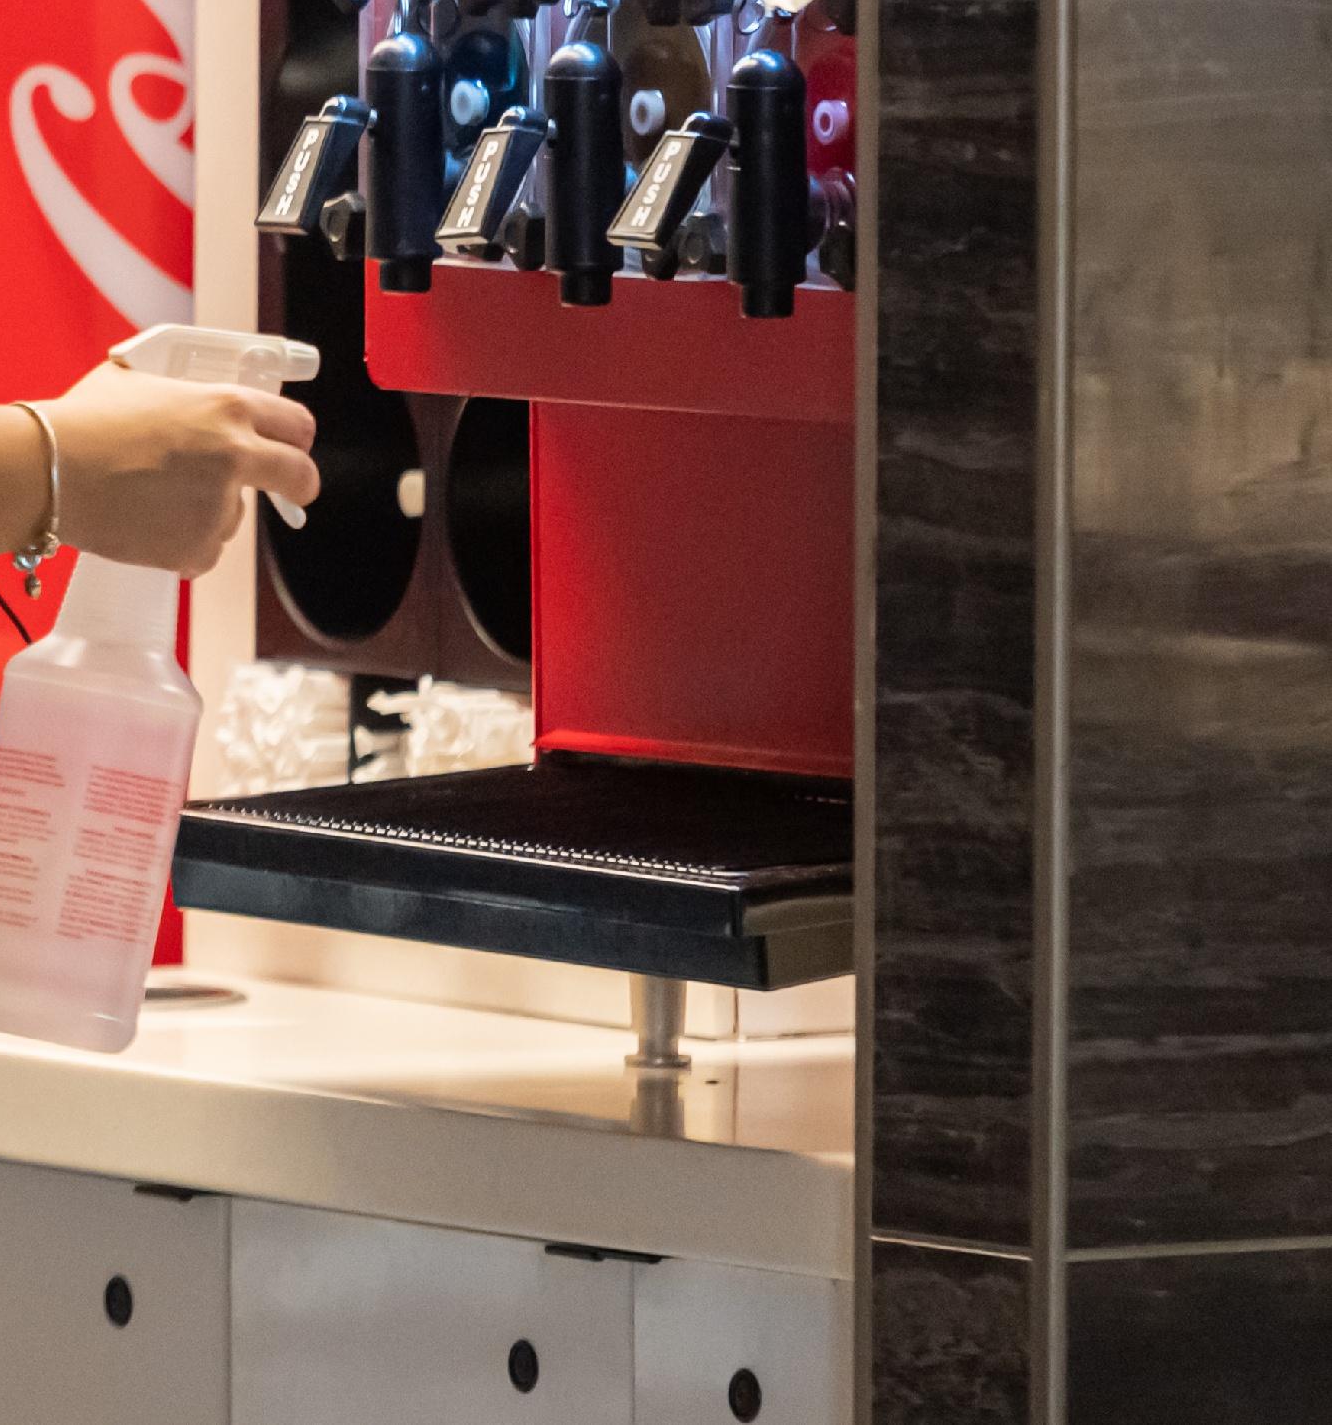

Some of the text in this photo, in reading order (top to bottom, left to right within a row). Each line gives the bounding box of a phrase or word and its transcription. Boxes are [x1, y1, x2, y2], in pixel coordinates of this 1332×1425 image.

[275, 127, 320, 216] PUSH
[455, 140, 500, 228] PUSH
[630, 140, 683, 227] PUSH
